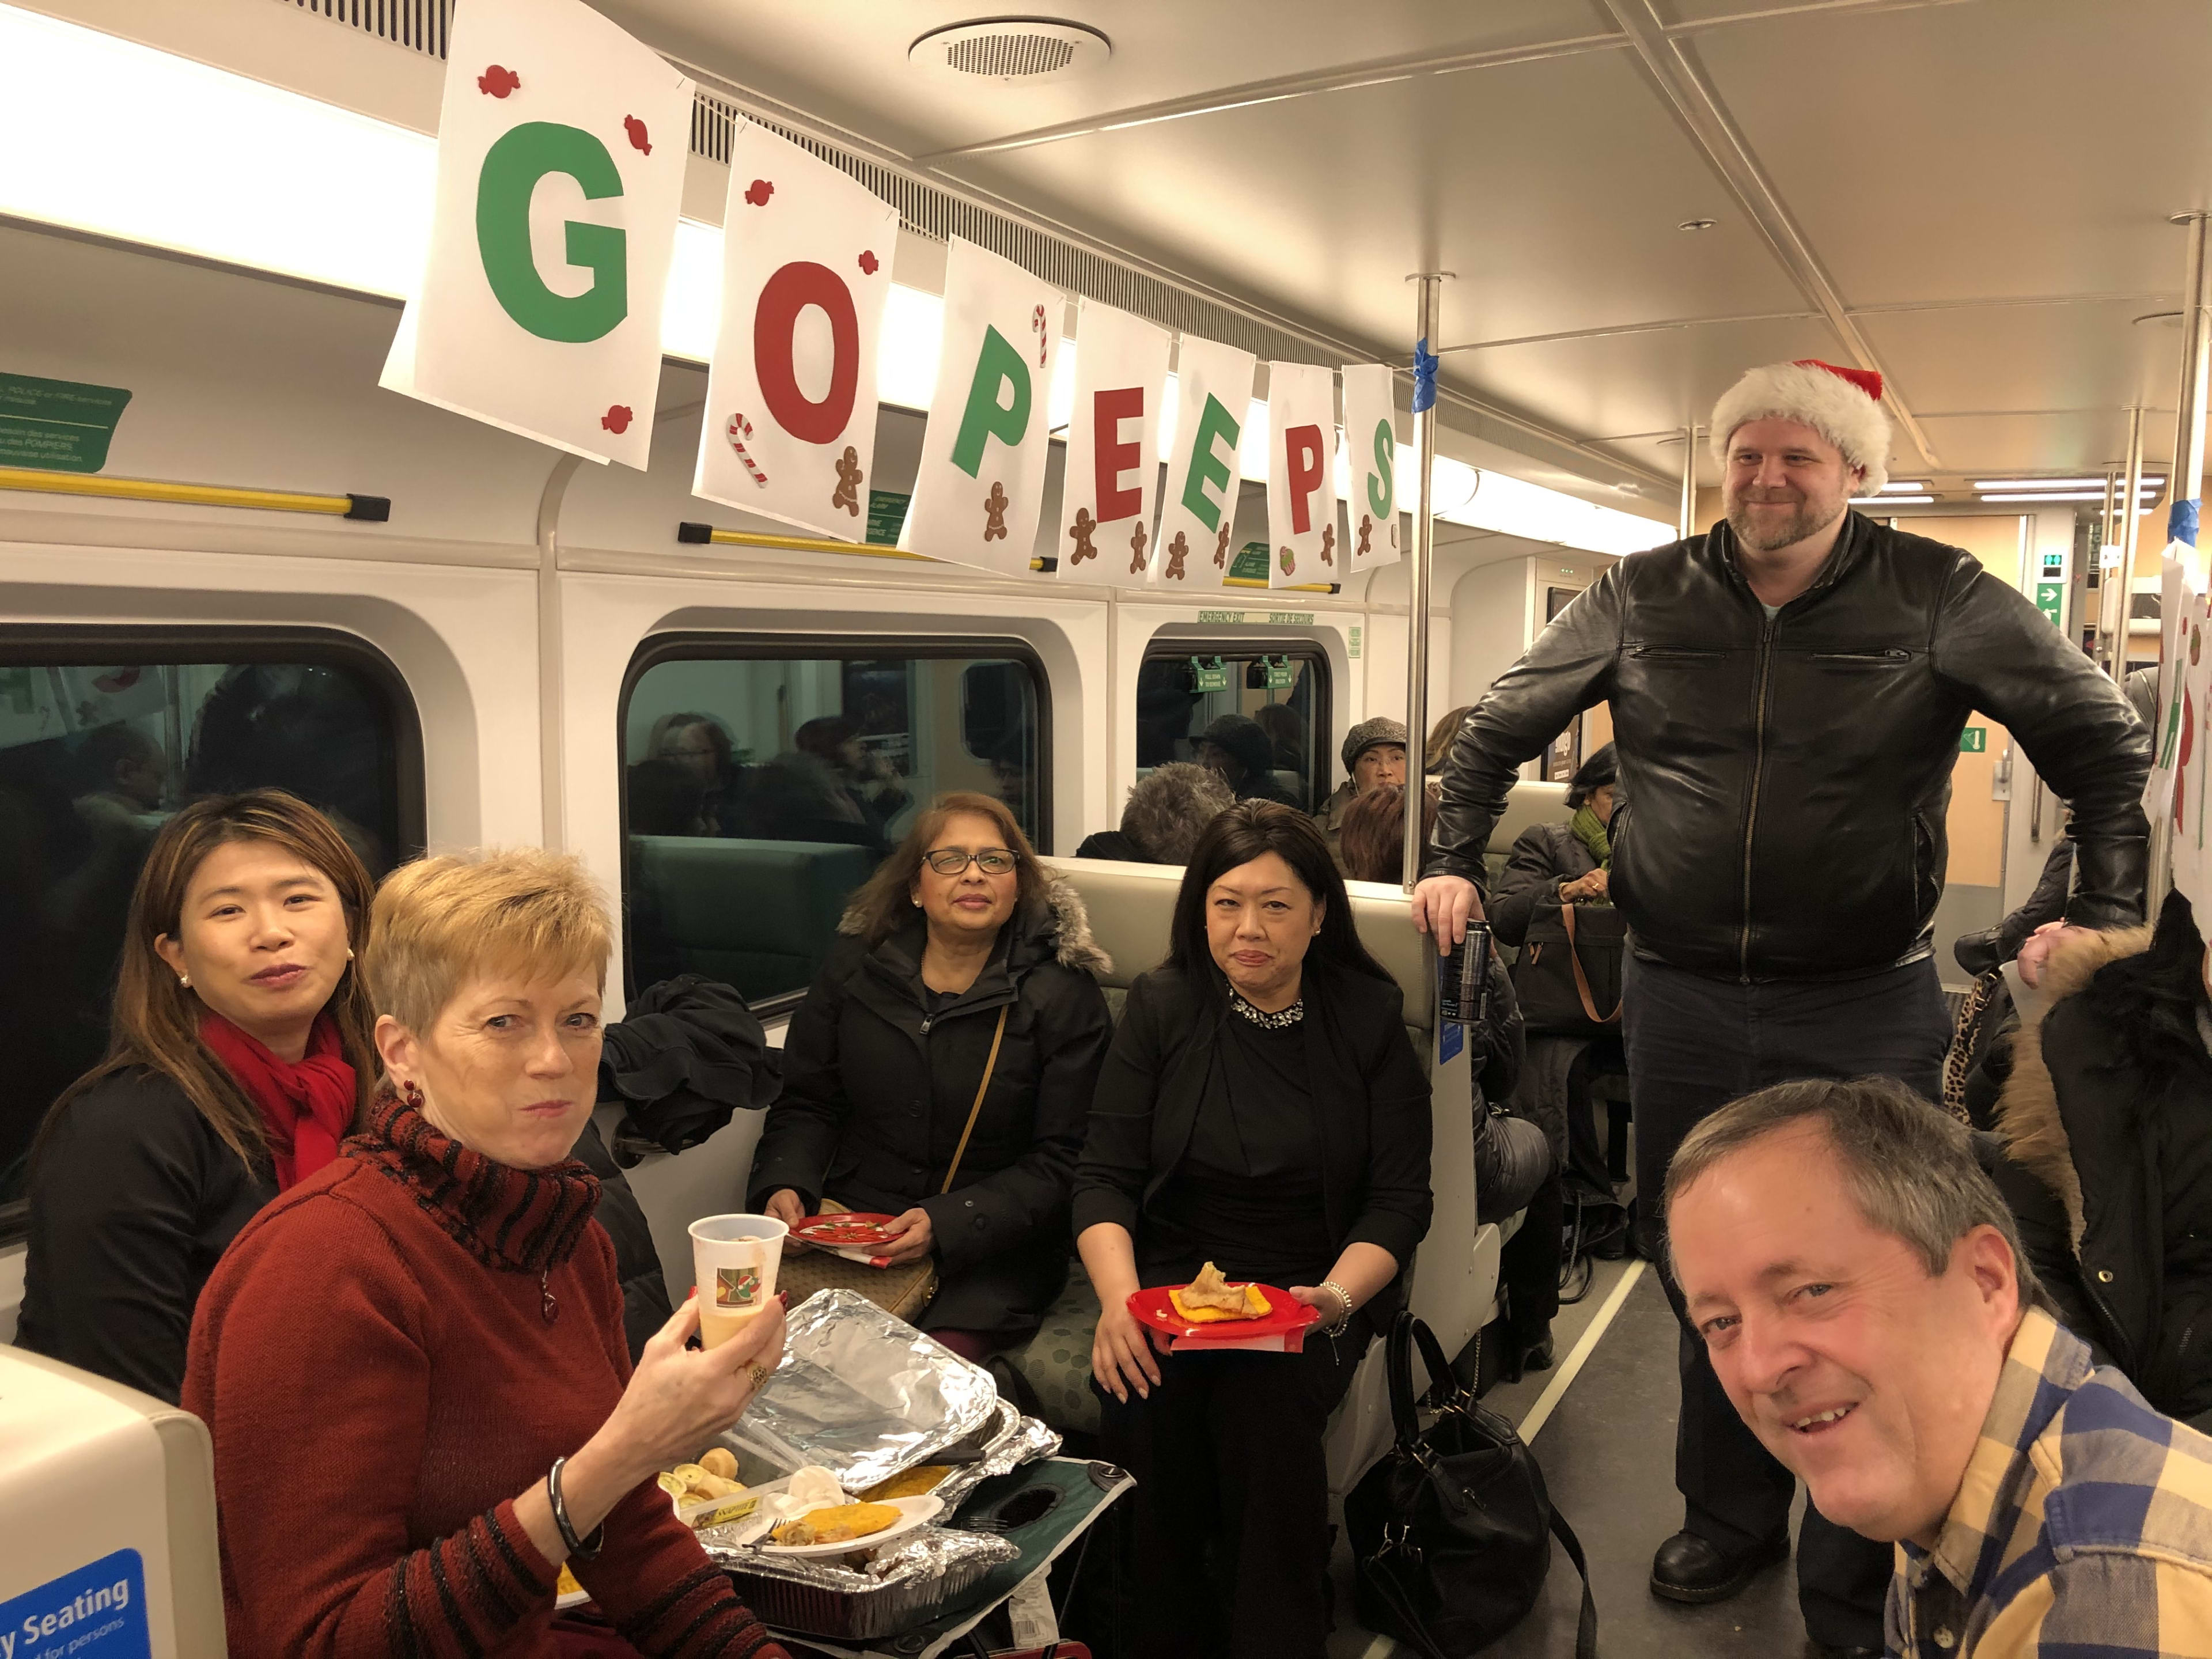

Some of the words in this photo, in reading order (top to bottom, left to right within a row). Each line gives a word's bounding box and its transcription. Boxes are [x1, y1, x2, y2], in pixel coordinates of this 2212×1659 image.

[1199, 611, 1232, 622] EMERGENCY
[1233, 612, 1245, 623] EXIT
[23, 1578, 128, 1645] Seating
[69, 1617, 124, 1655] persons
